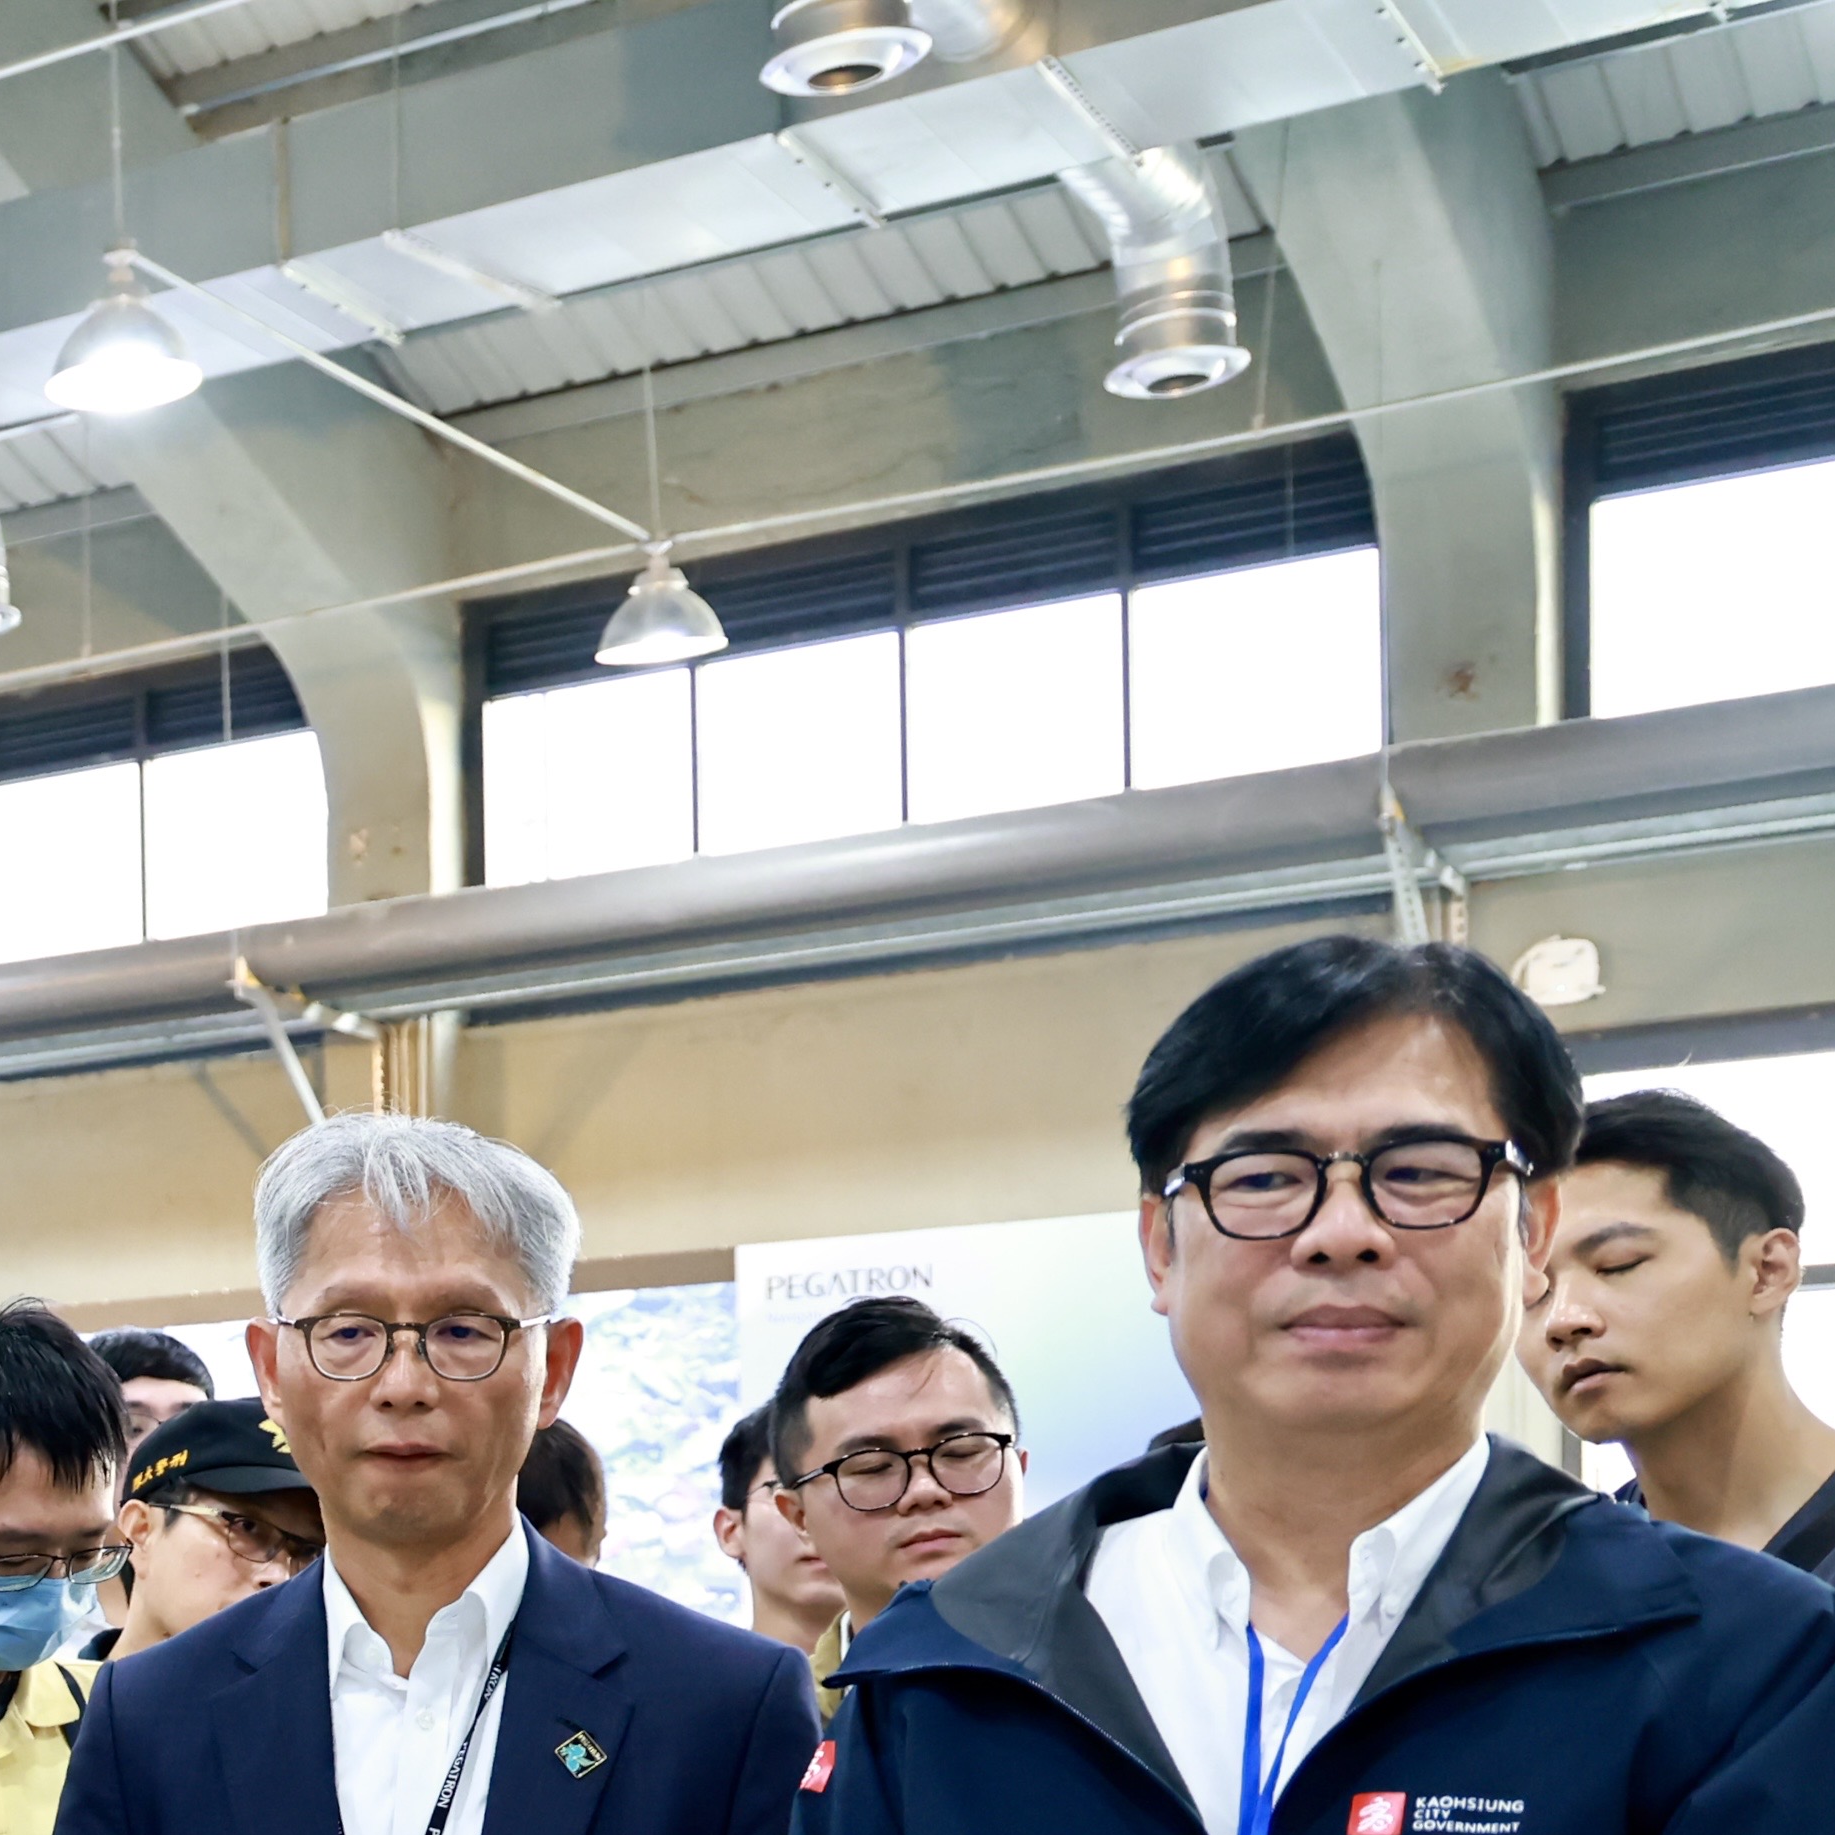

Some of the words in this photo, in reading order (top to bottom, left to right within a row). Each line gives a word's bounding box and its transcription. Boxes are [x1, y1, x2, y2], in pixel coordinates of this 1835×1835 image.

[765, 1264, 933, 1300] PEGATRON
[1415, 1796, 1525, 1813] KAOHSIUNG
[1414, 1809, 1450, 1819] CITY
[1412, 1819, 1520, 1834] GOVERNMENT
